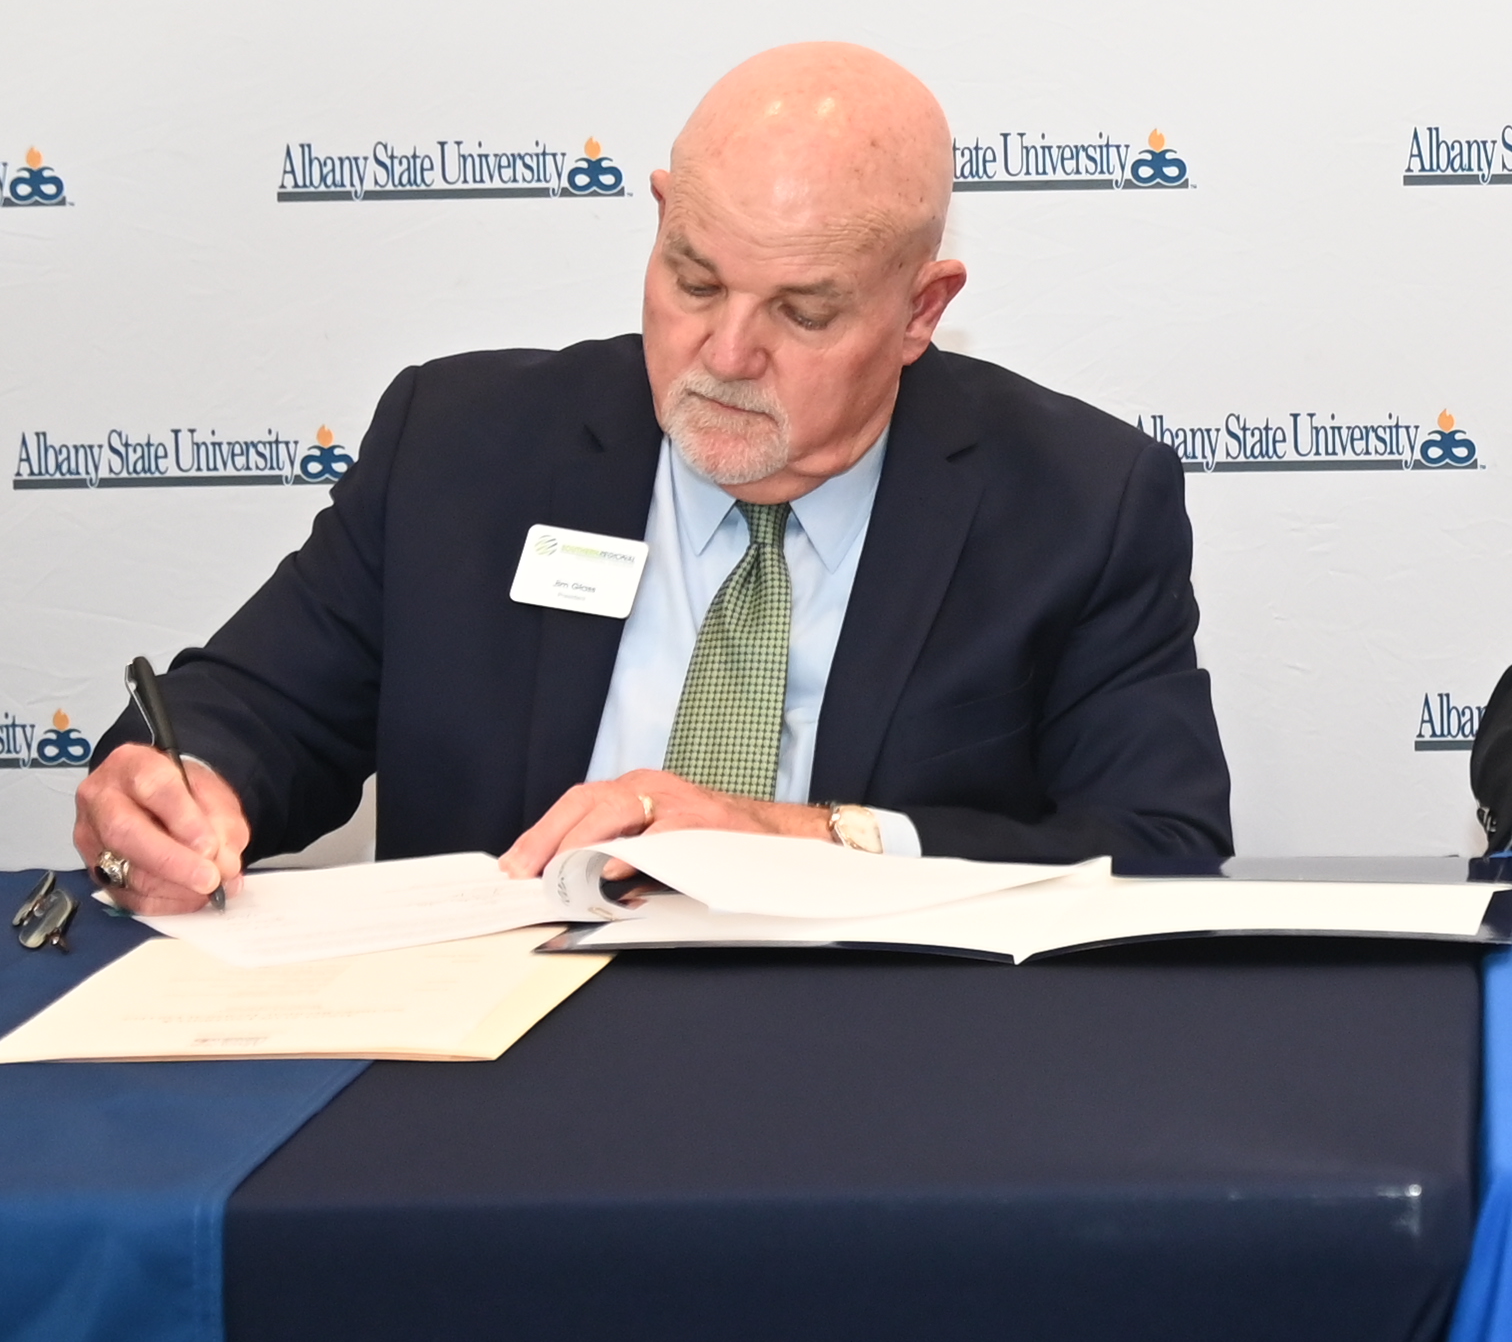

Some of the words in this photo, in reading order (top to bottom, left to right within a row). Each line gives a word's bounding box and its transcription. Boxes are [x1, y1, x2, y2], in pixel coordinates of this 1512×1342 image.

[279, 143, 368, 200] Albany
[372, 140, 435, 189] State
[437, 139, 566, 197] University
[953, 139, 997, 180] tate
[1000, 131, 1130, 189] University
[1405, 126, 1497, 184] Albany
[15, 431, 105, 488] Albany
[107, 428, 170, 476] State
[171, 427, 298, 484] University
[1135, 414, 1220, 471] lbany
[1223, 412, 1286, 460] State
[1288, 412, 1418, 470] University
[1415, 692, 1486, 739] Alba
